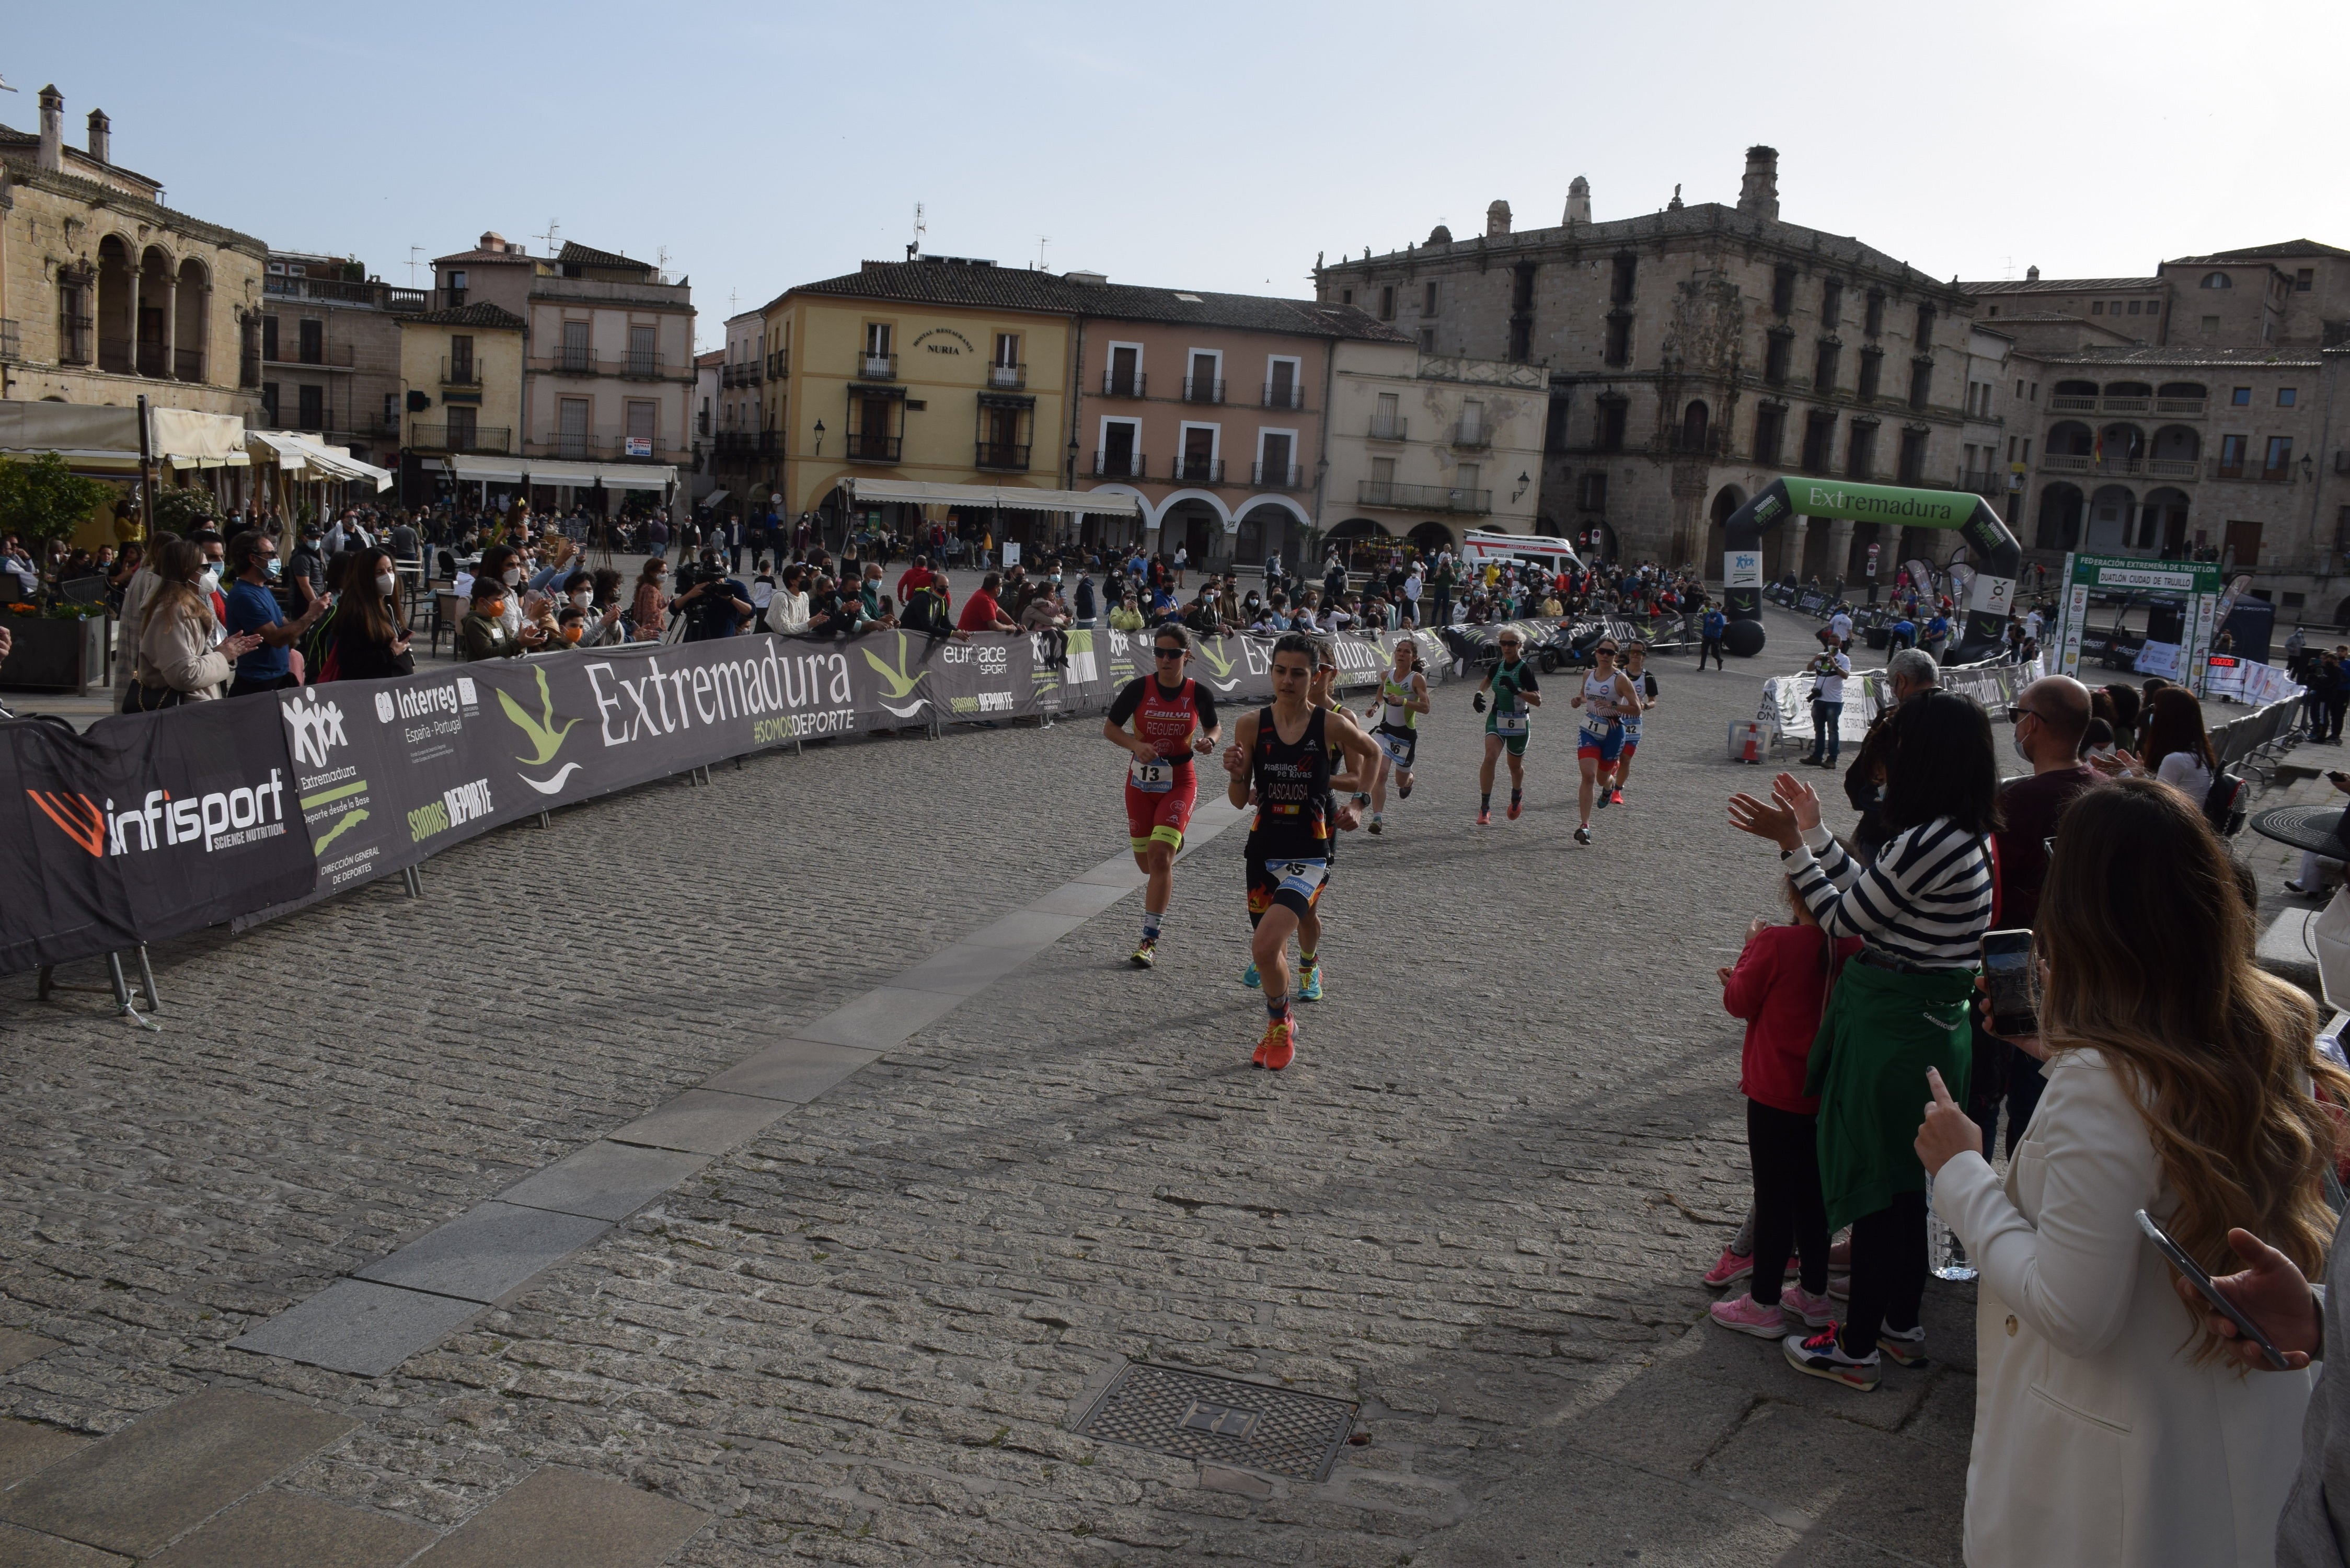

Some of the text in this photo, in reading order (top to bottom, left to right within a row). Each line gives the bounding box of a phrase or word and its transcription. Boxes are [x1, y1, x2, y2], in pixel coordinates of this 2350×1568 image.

[913, 328, 974, 353] HOSTAL RESTAURANTE
[928, 345, 959, 355] NURIA
[1754, 499, 1782, 523] DEPORTE
[1810, 487, 1951, 520] Extremadura
[2080, 557, 2125, 567] FEDERACIÓN
[2127, 561, 2167, 571] EXTREMEÑA
[2101, 573, 2126, 582] DUATLÓN
[2129, 575, 2150, 584] CIUDAD
[2164, 578, 2191, 586] TRUJILLO
[981, 664, 1007, 674] SPORT
[1334, 671, 1377, 686] SOMOSDEPORTE
[584, 636, 851, 747] Extremadura
[978, 691, 1013, 711] DEPORTE
[395, 685, 457, 719] Interreg
[1145, 710, 1191, 719] ISBILYA
[1508, 720, 1515, 728] 6
[405, 724, 431, 744] España
[434, 716, 462, 734] Portugal
[754, 709, 854, 744] #SOMOSDEPORTE
[1147, 722, 1185, 735] REGUERO
[1588, 721, 1598, 732] 11
[300, 766, 356, 790] Extremadura
[1141, 766, 1159, 781] 13
[1268, 783, 1308, 800] CASCAJOSA
[106, 768, 283, 857] infisport
[329, 804, 348, 815] desde
[349, 799, 354, 809] la
[355, 797, 370, 806] Base
[408, 778, 493, 842] SOMOS DEPORTE
[214, 831, 245, 850] SCIENCE
[321, 846, 380, 875] DIRECCIÓN GENERAL
[333, 862, 372, 884] DE DEPORTES
